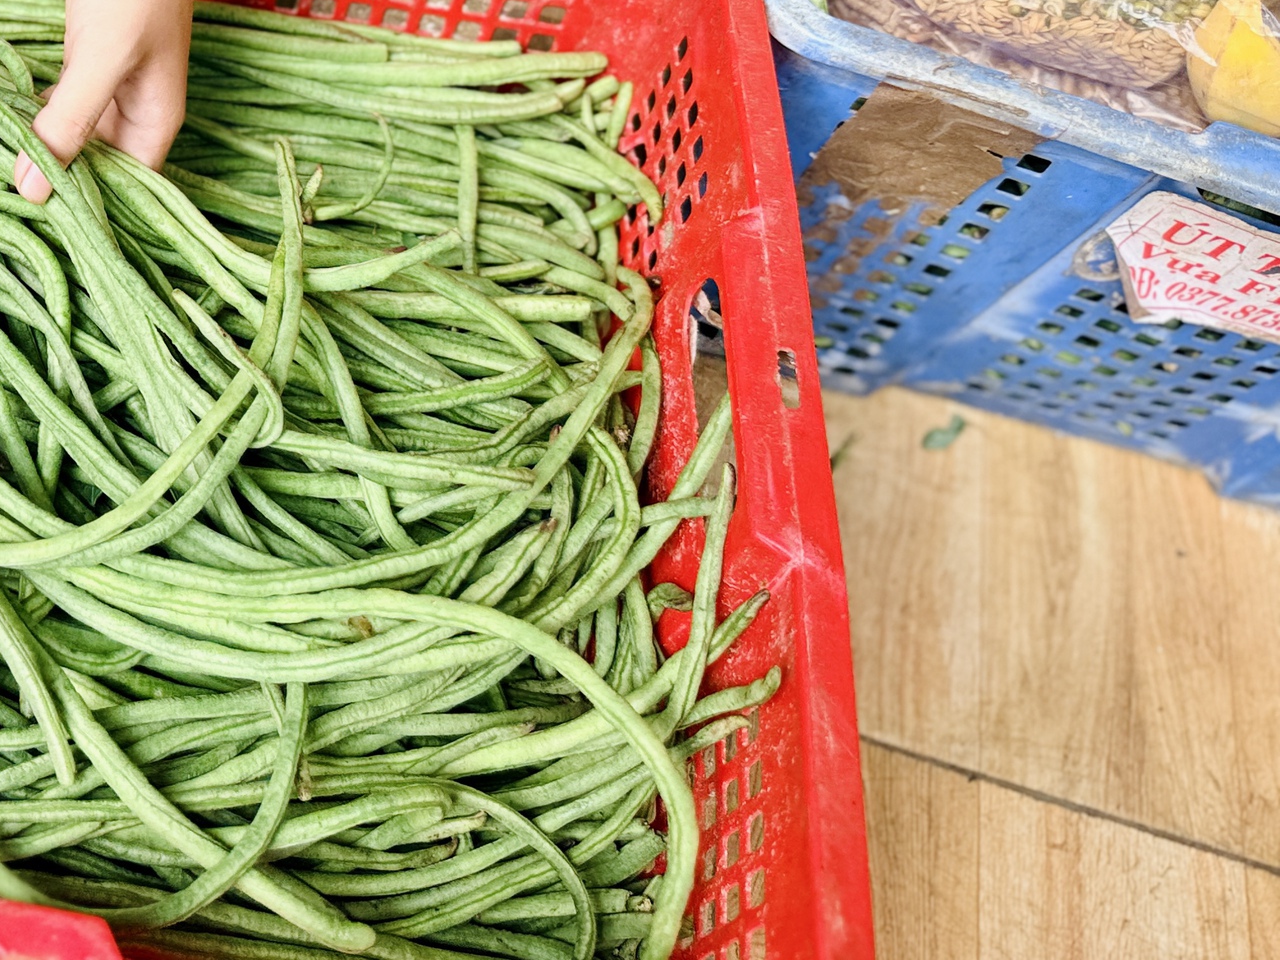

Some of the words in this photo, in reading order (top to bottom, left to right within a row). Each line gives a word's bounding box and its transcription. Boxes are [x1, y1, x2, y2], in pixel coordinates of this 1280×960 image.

[1142, 241, 1221, 284] Vựa
[1233, 277, 1280, 306] F
[1162, 219, 1246, 261] ÚT
[1250, 253, 1280, 281] T
